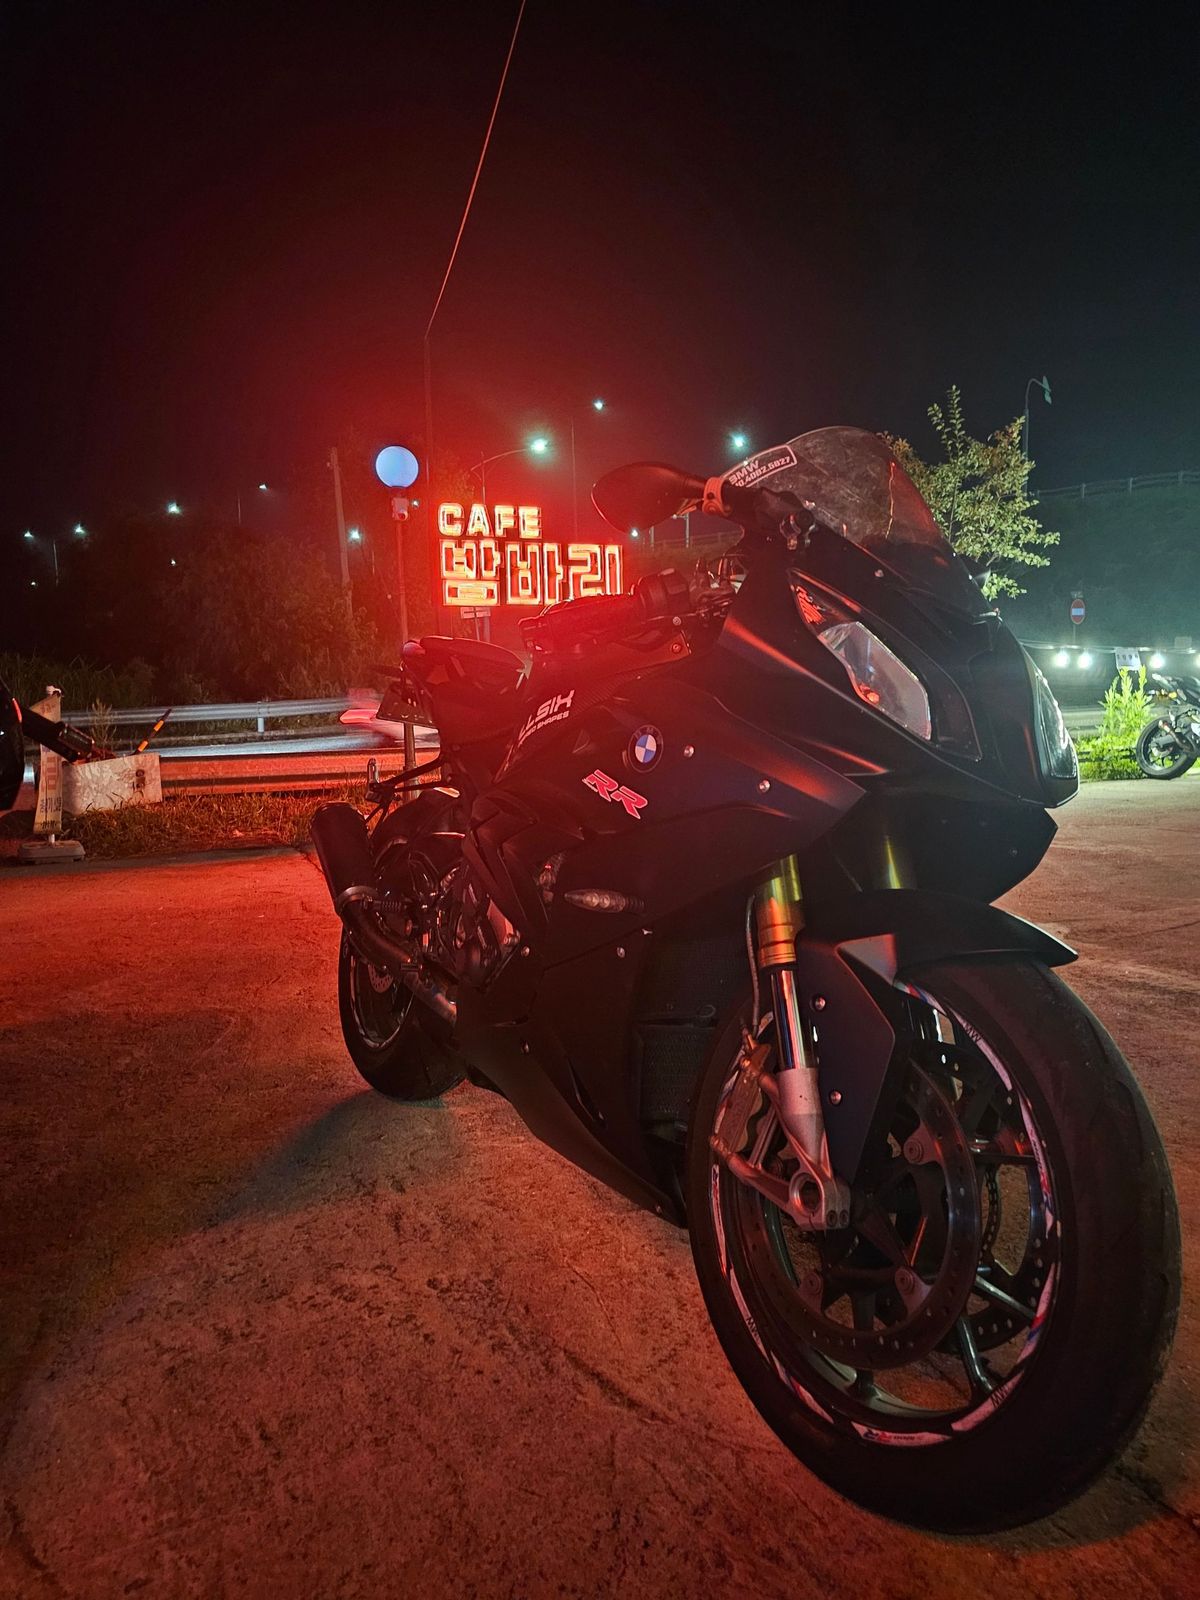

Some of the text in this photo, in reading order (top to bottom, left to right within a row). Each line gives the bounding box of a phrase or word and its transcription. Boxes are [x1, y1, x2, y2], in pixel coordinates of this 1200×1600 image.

[729, 460, 759, 485] BMW
[438, 502, 542, 539] CAFE
[439, 539, 623, 606] 밤바리
[581, 768, 649, 820] RR
